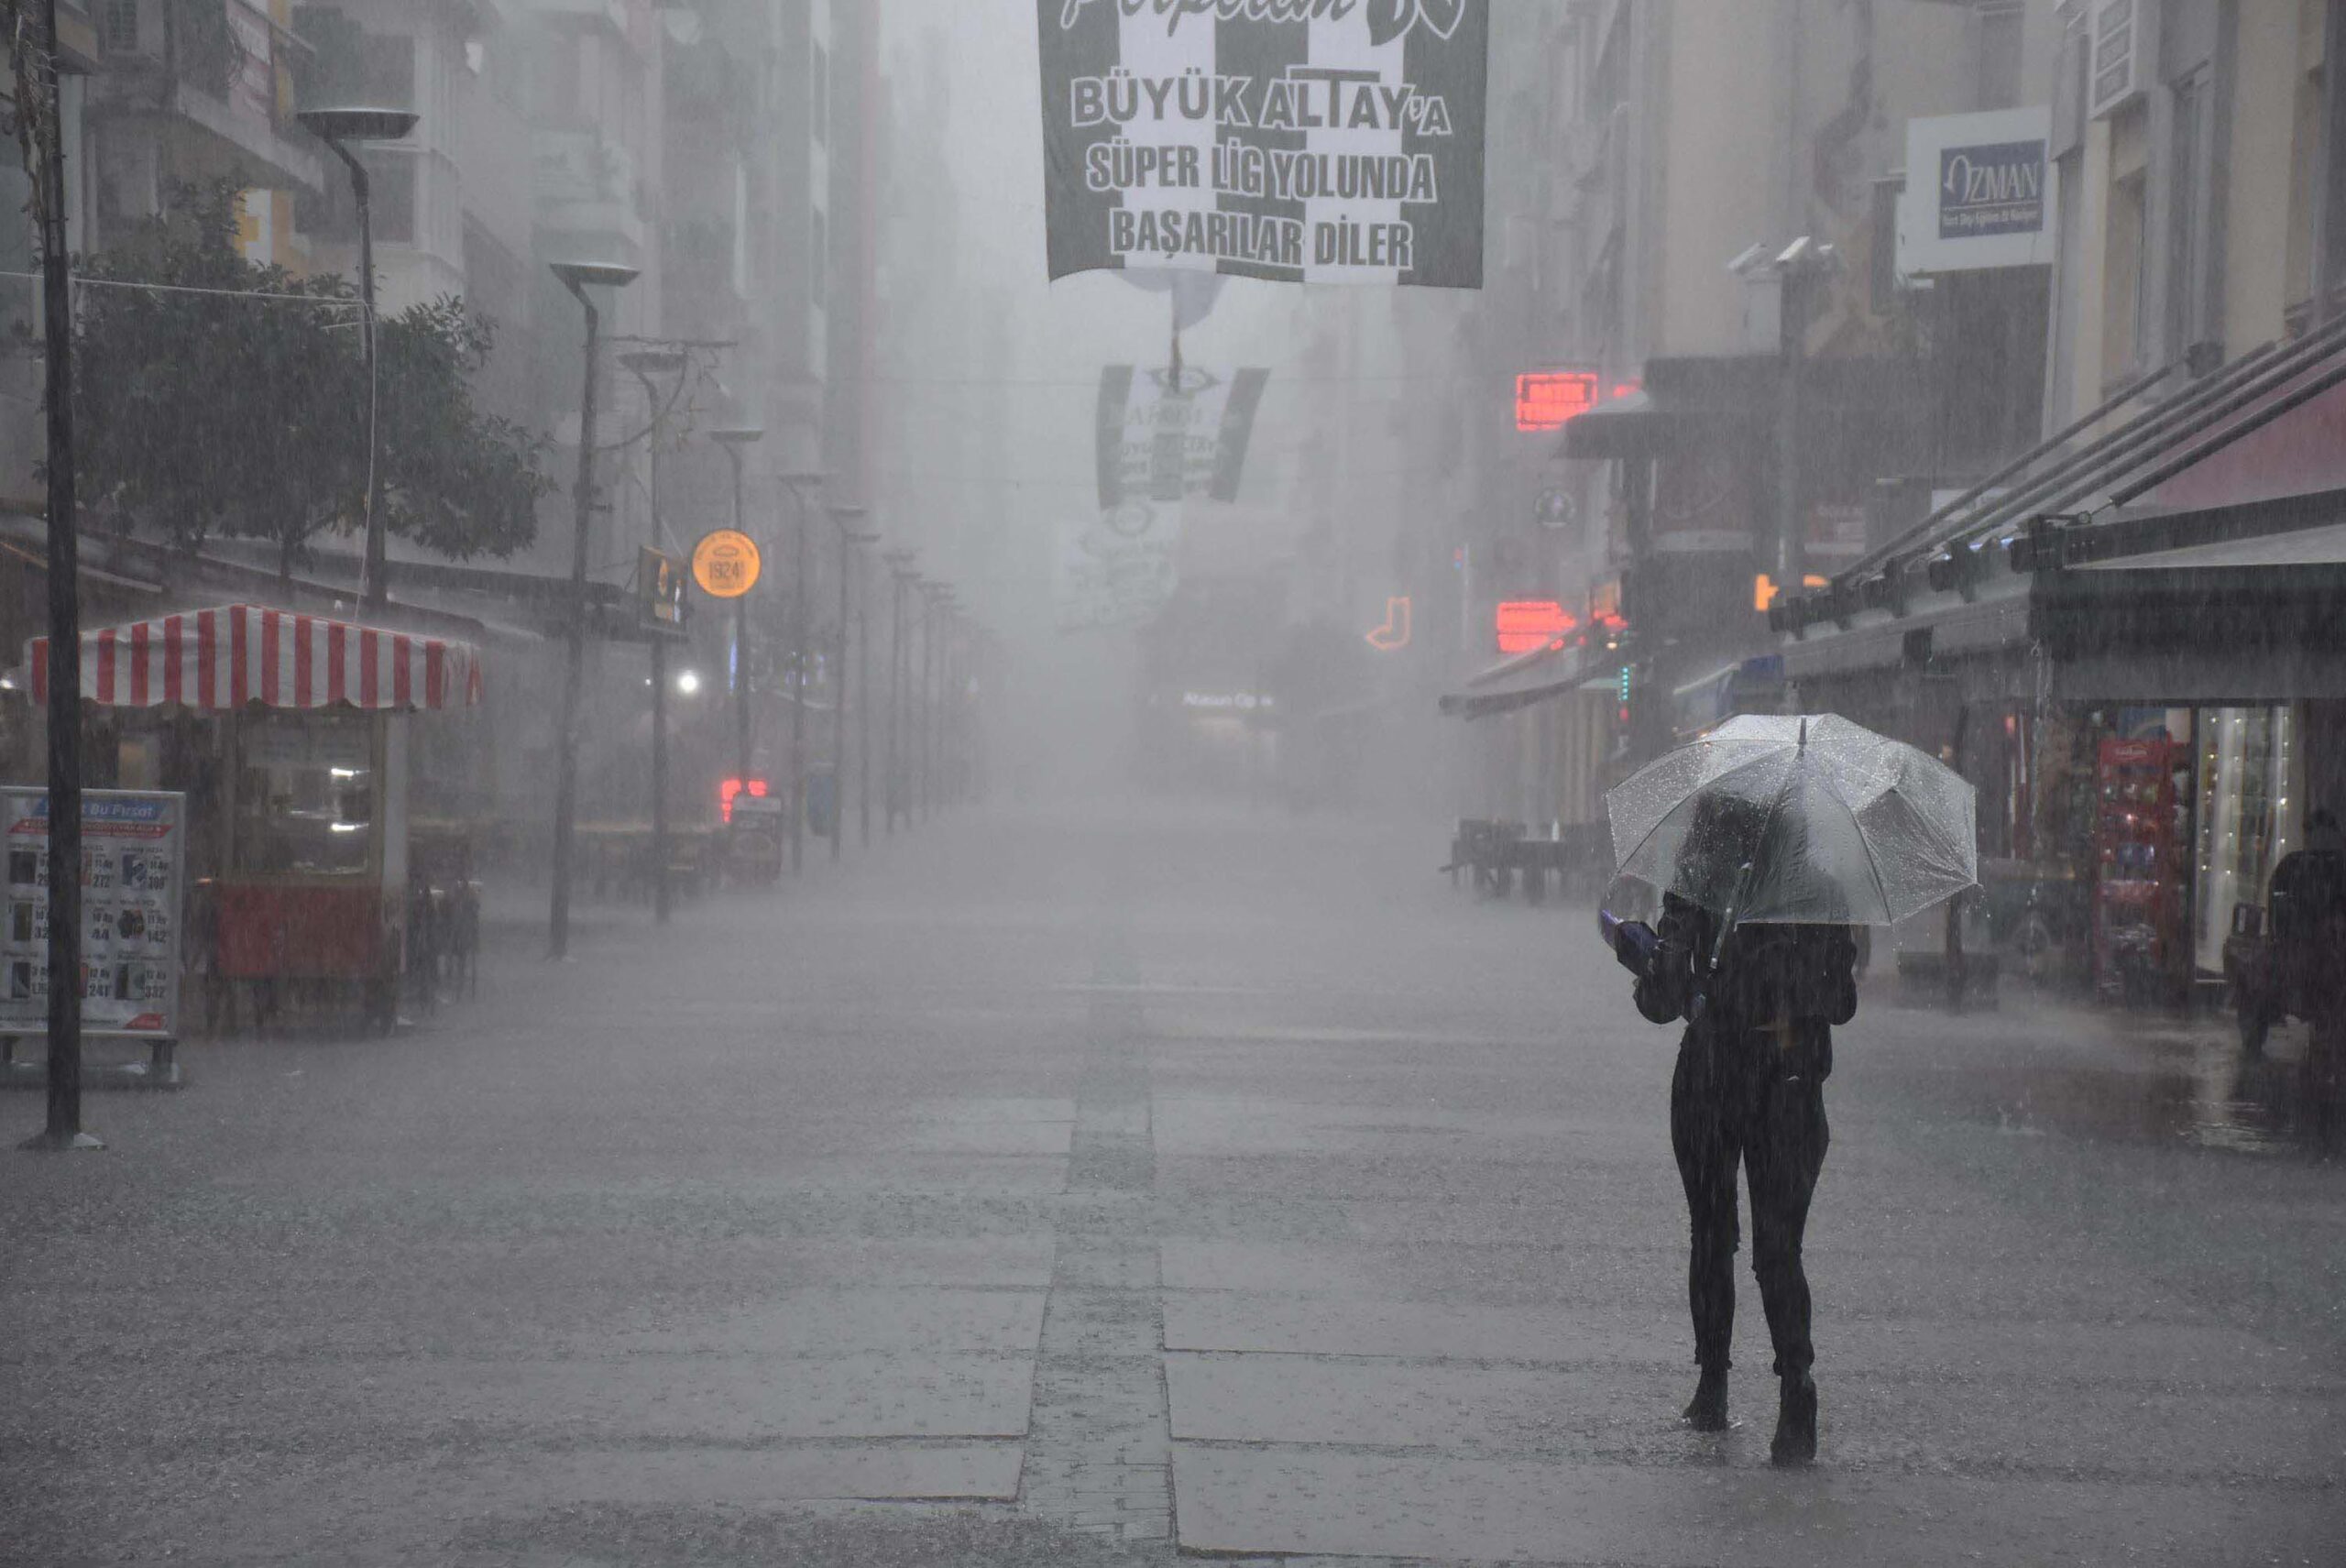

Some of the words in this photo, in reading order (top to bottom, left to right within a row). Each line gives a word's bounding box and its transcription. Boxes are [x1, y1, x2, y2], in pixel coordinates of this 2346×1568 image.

[1071, 67, 1252, 126] BÜYÜK
[1259, 66, 1453, 136] ALTAY'A
[1086, 137, 1200, 192] SÜPER
[1211, 137, 1265, 197] LİG
[1269, 149, 1437, 203] YOLUNDA
[1110, 208, 1304, 266] BAŞARILAR
[1314, 214, 1413, 270] DİLER
